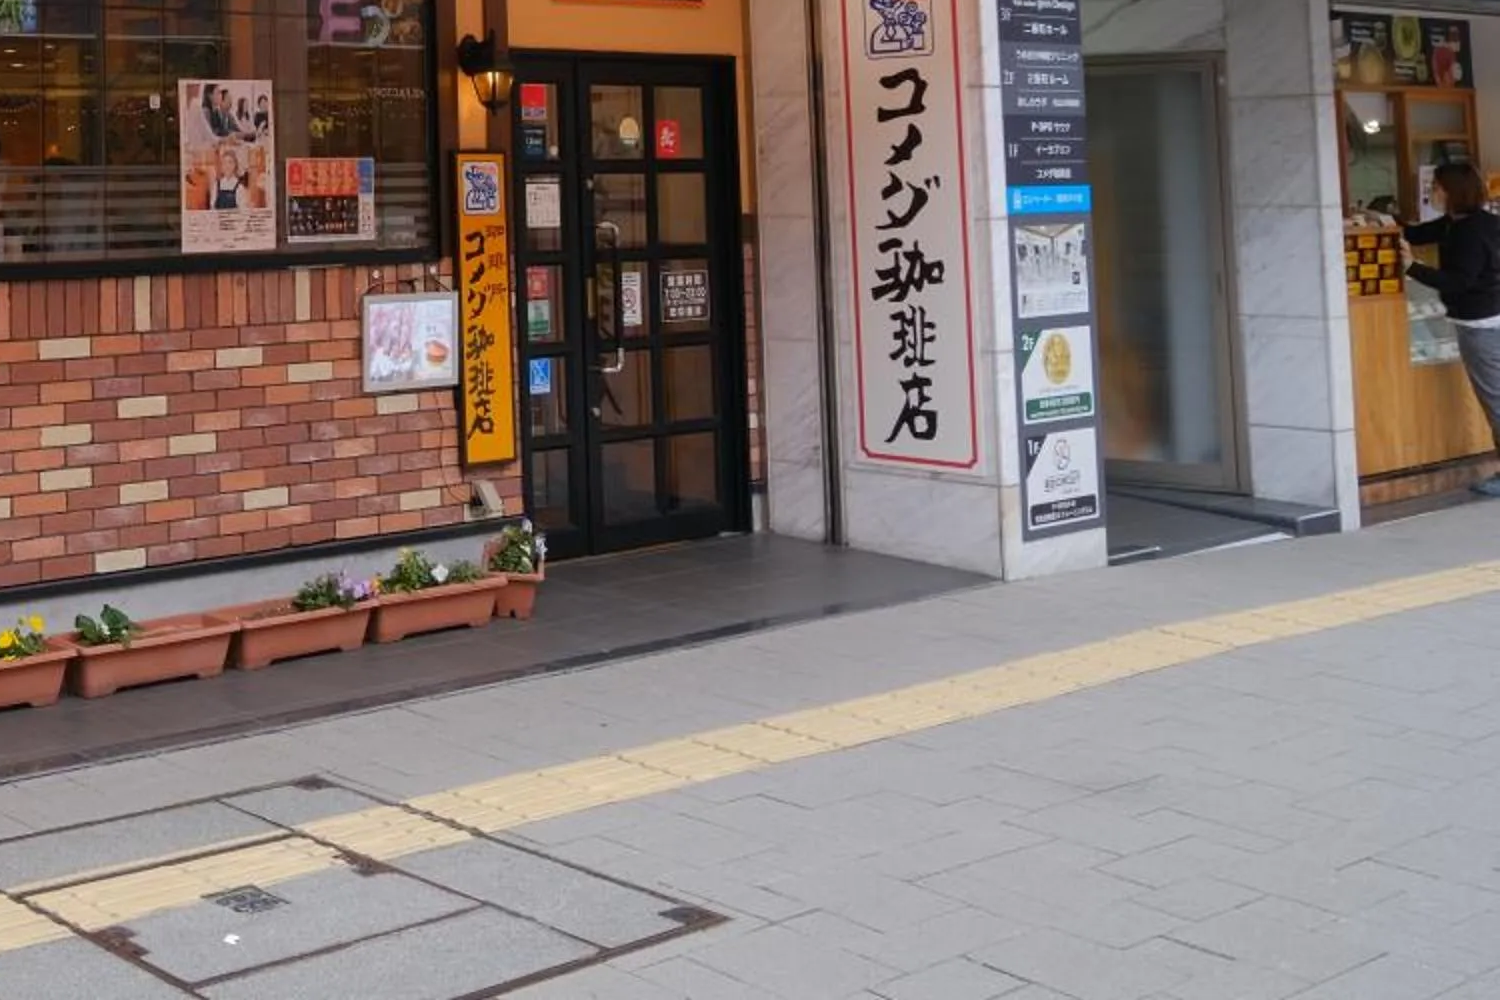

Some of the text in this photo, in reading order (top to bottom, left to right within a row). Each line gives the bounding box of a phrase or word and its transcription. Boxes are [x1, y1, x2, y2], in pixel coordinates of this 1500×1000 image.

[871, 68, 945, 443] コメダ珈琲店
